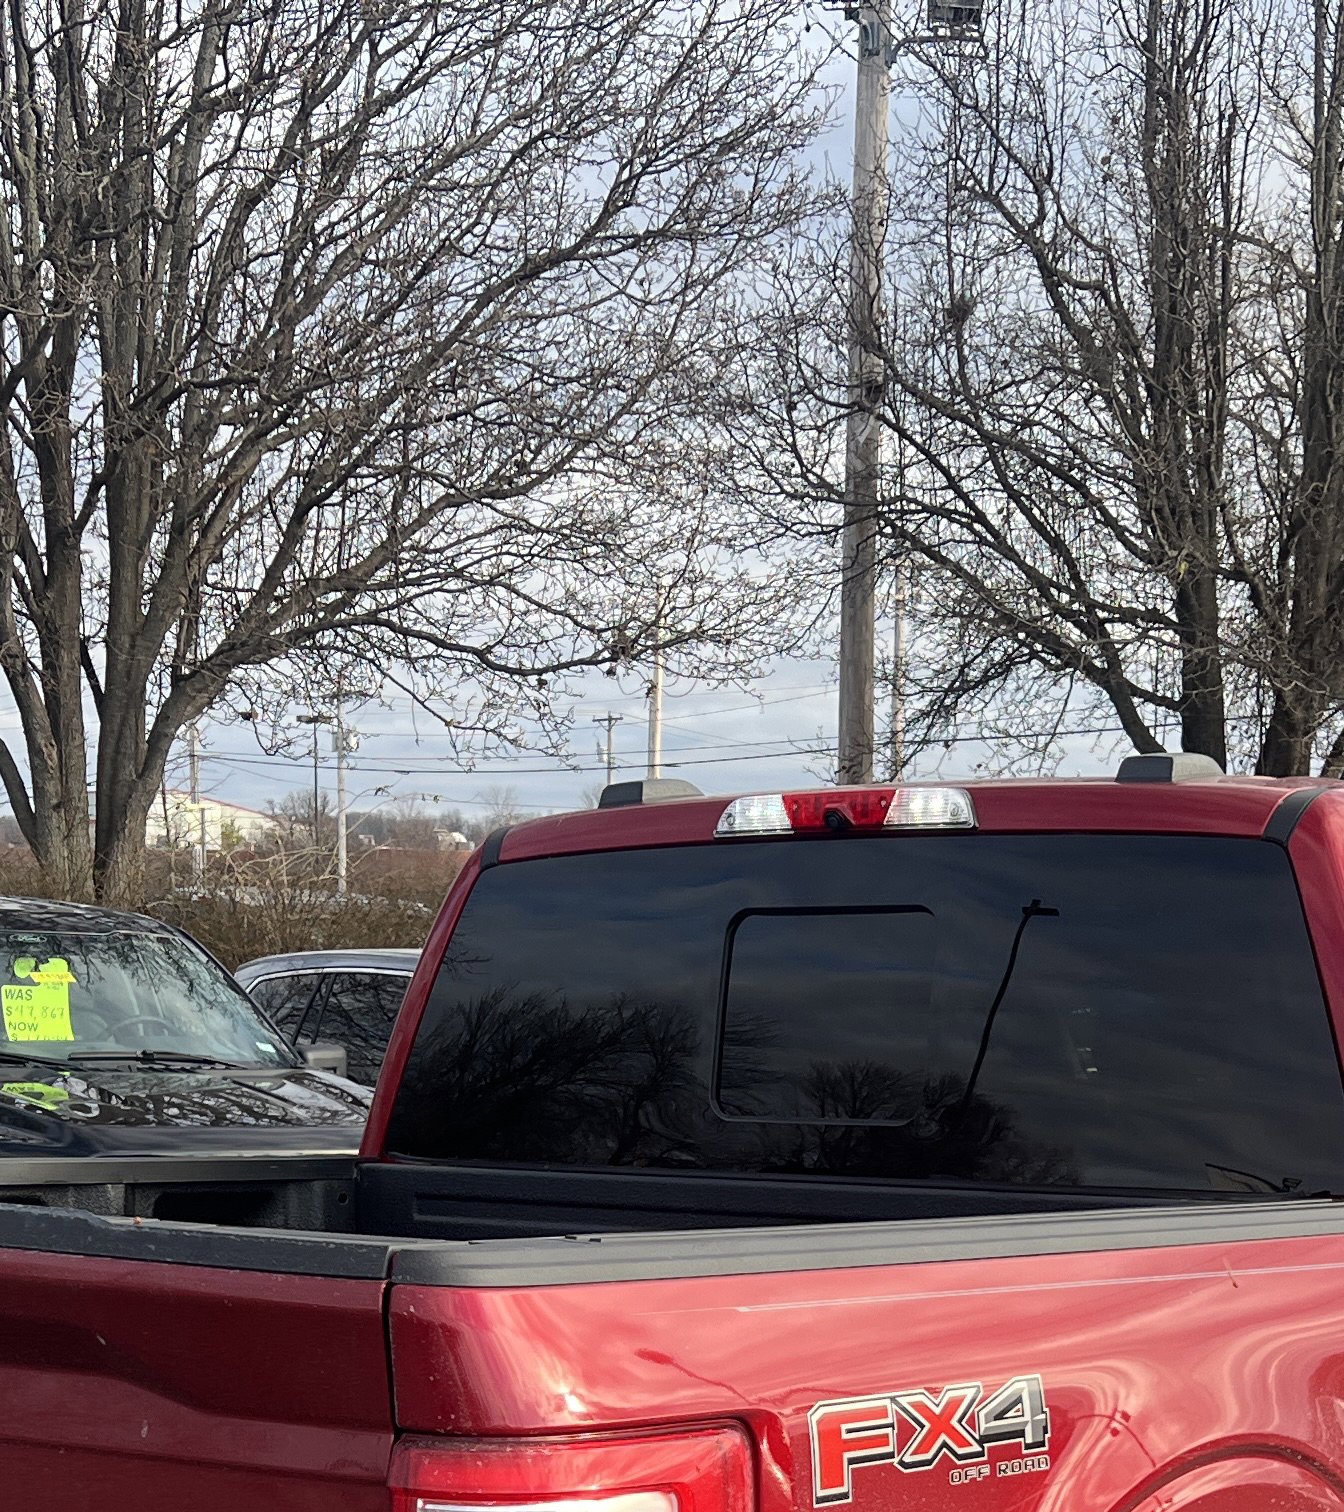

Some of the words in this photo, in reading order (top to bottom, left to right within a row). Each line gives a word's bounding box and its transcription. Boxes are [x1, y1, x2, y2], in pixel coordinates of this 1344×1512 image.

[4, 988, 33, 1001] WAS
[8, 1021, 38, 1032] NOW
[808, 1374, 1052, 1508] FX4
[949, 1464, 991, 1486] OFF
[997, 1456, 1050, 1477] ROAD
